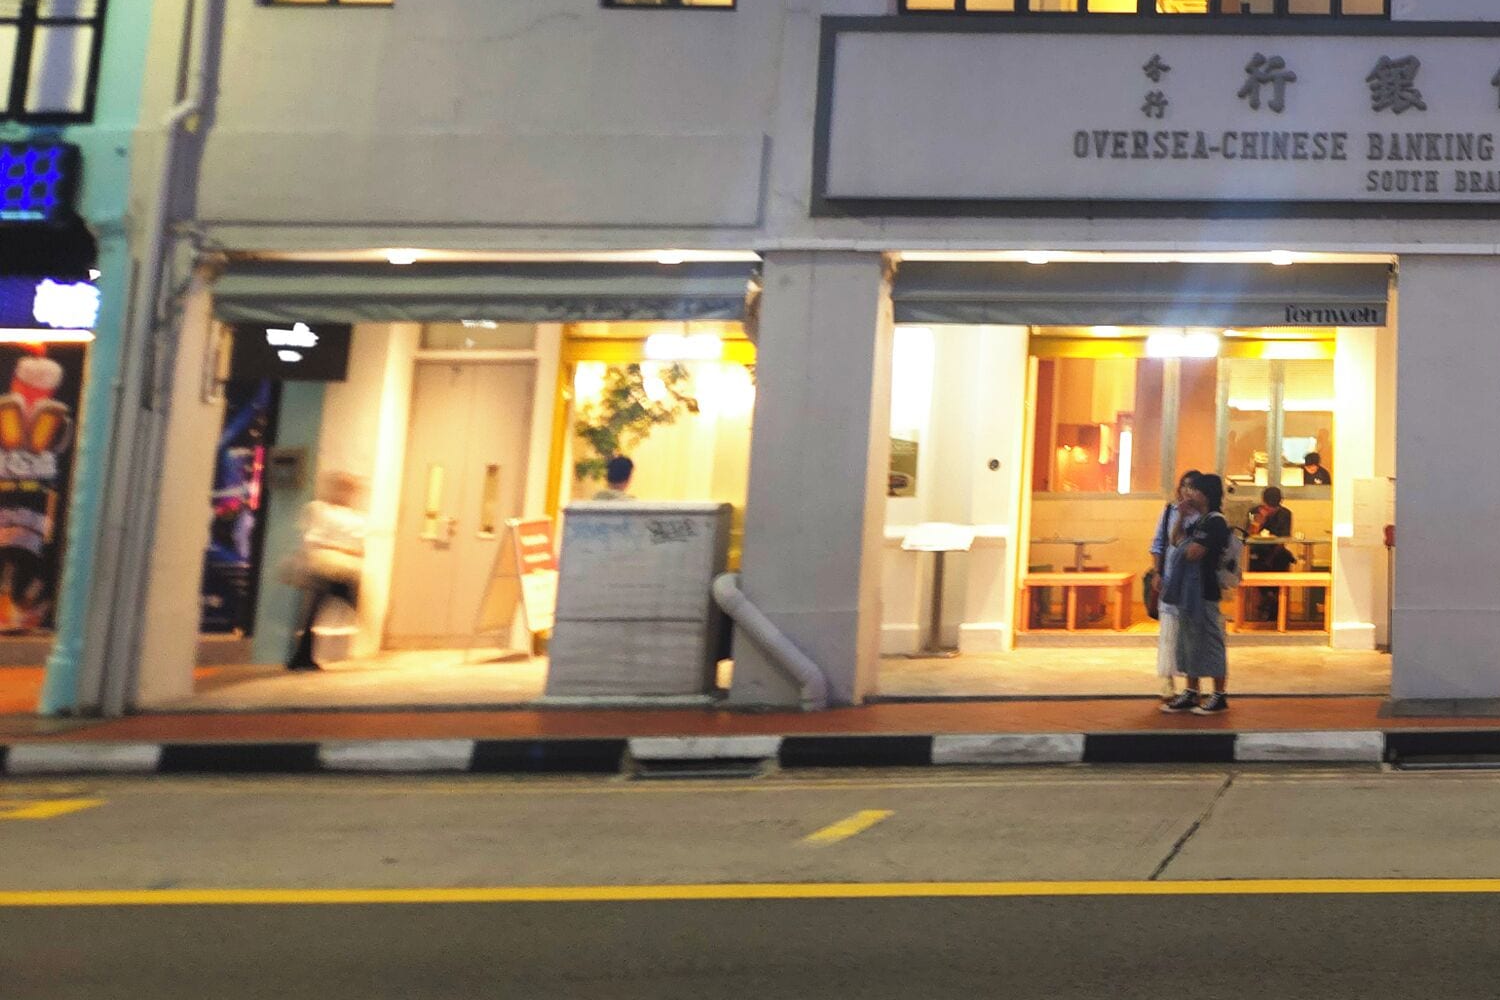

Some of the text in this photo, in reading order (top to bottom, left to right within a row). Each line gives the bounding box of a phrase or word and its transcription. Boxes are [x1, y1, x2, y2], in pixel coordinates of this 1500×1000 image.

[1073, 130, 1348, 160] OVERSEA-CHINESE
[1366, 132, 1494, 162] BANKING
[1365, 169, 1440, 193] SOUTH
